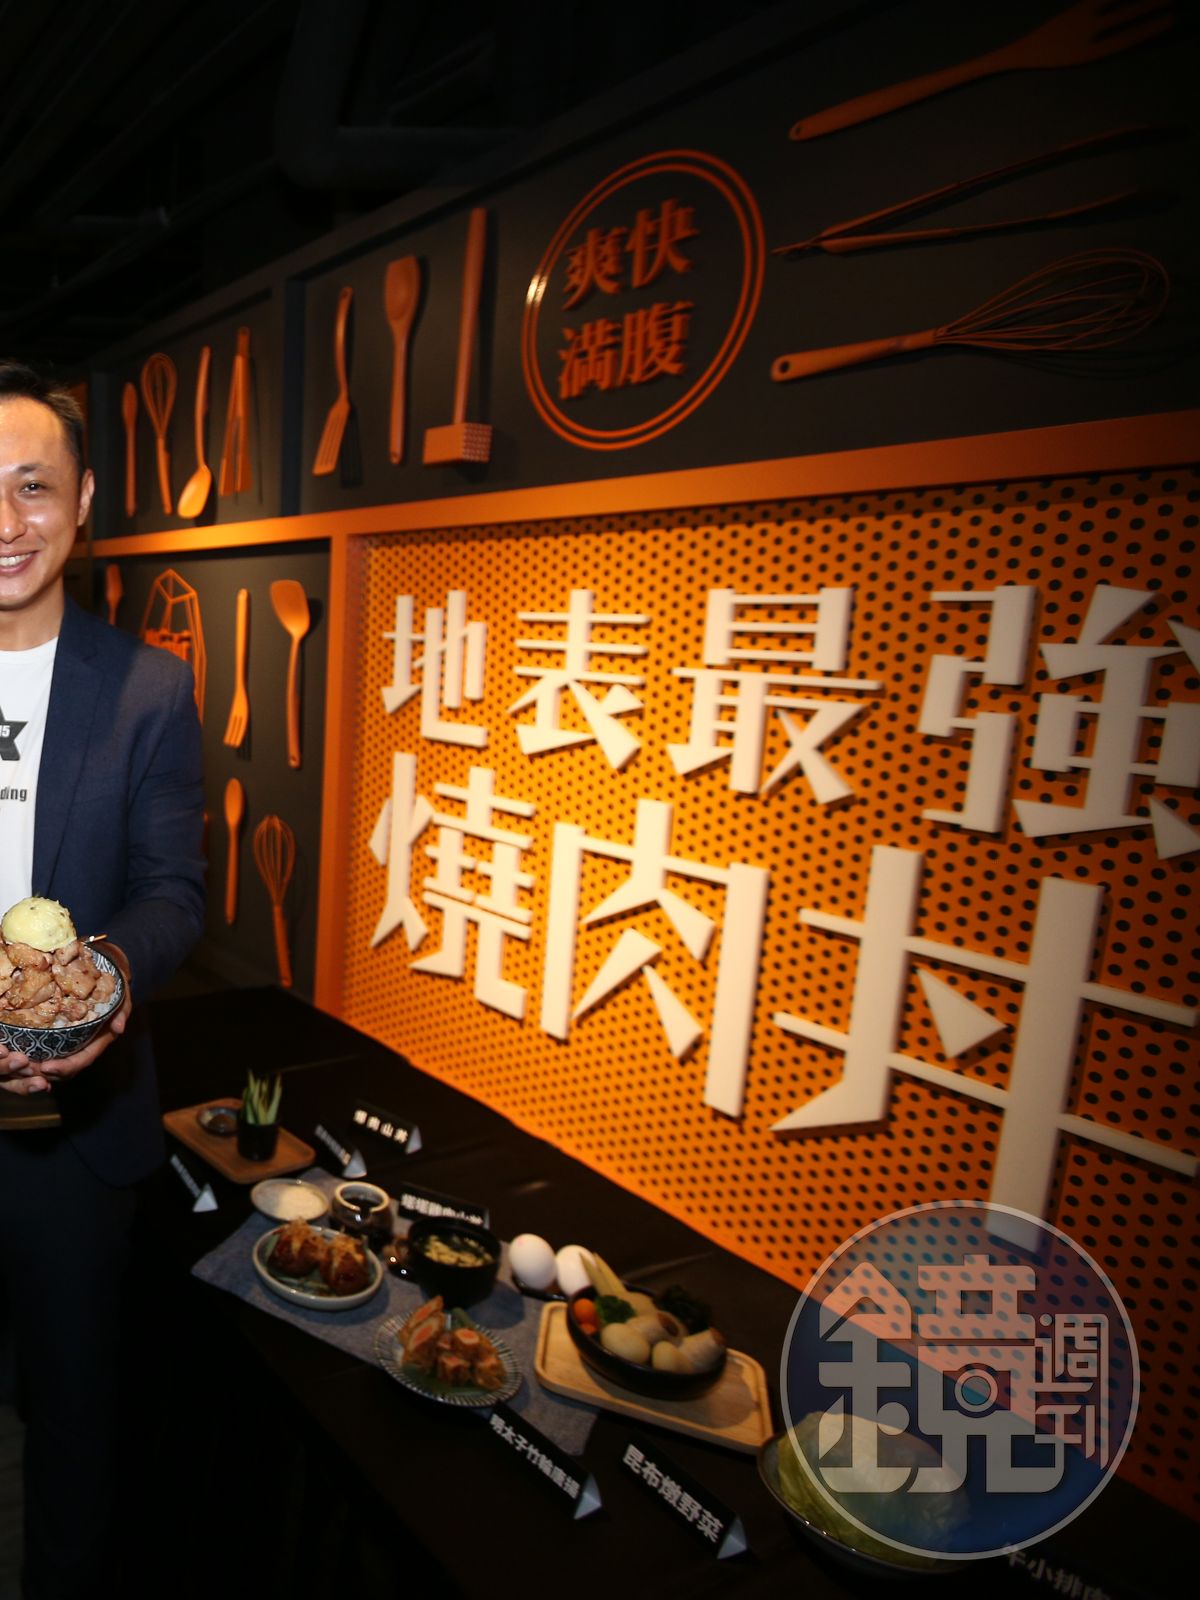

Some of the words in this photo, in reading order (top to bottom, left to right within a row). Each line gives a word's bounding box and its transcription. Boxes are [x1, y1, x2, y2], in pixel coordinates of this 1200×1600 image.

[561, 198, 700, 312] 爽快
[382, 584, 1200, 860] 地表最強
